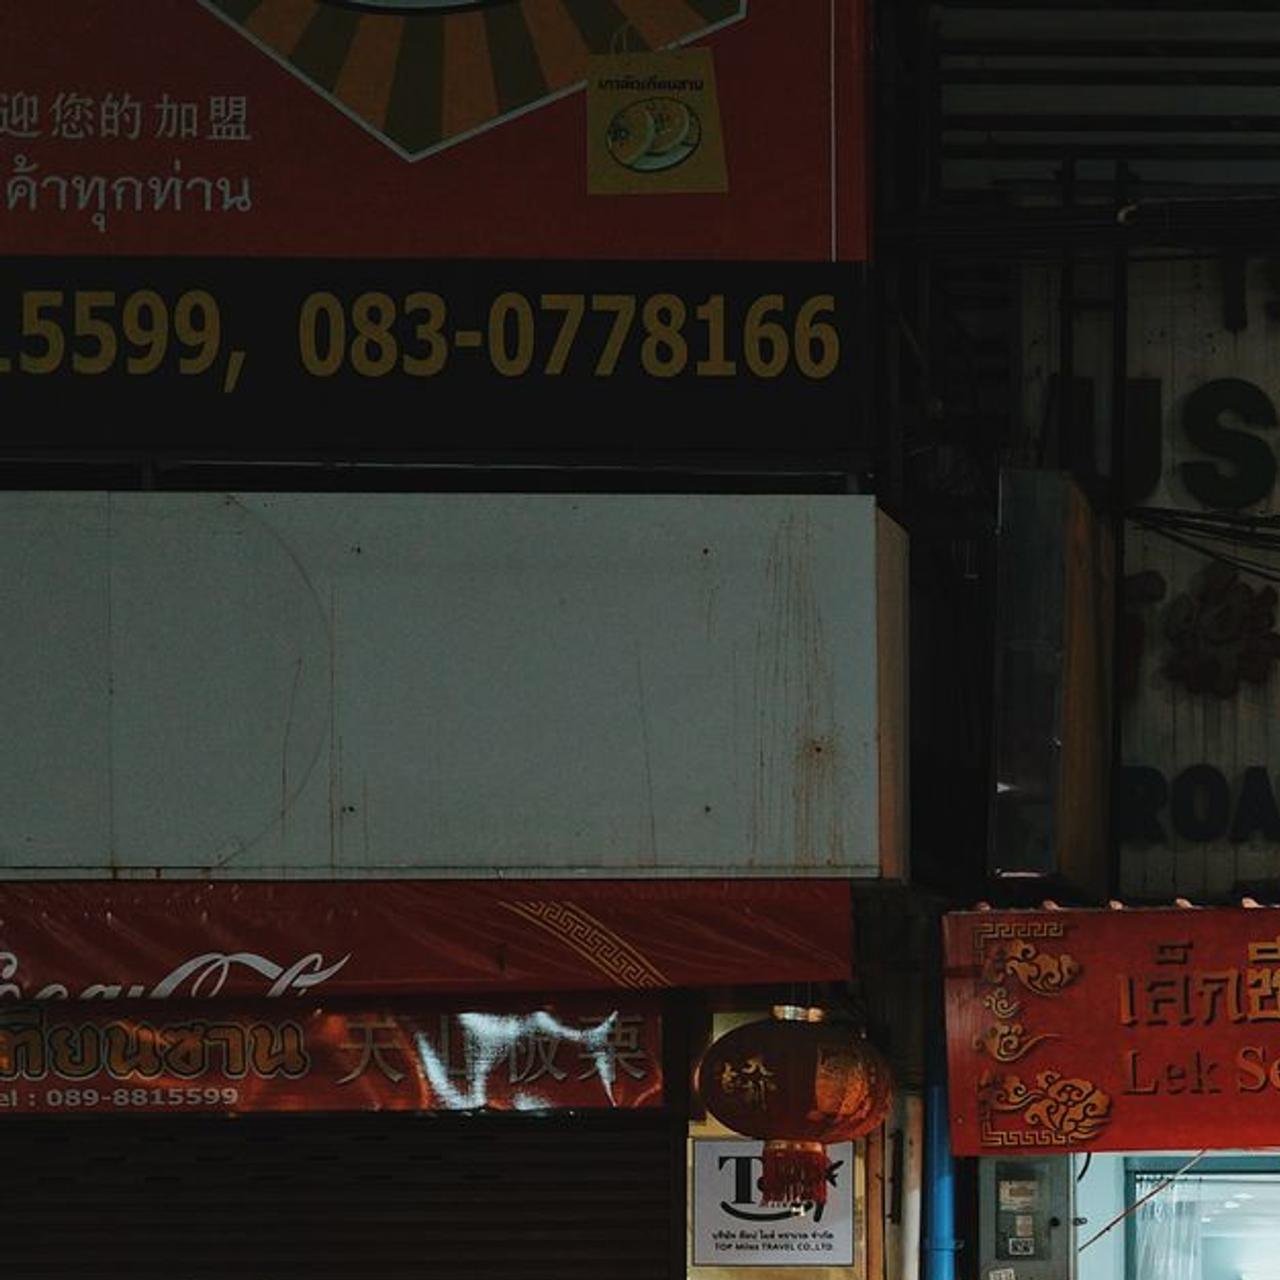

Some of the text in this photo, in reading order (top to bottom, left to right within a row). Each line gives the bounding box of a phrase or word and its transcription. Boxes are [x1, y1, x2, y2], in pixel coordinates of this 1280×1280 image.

[0, 289, 842, 393] 5599, 083-0778166
[1121, 1046, 1218, 1095] Lek
[46, 1087, 240, 1107] 089-8815599
